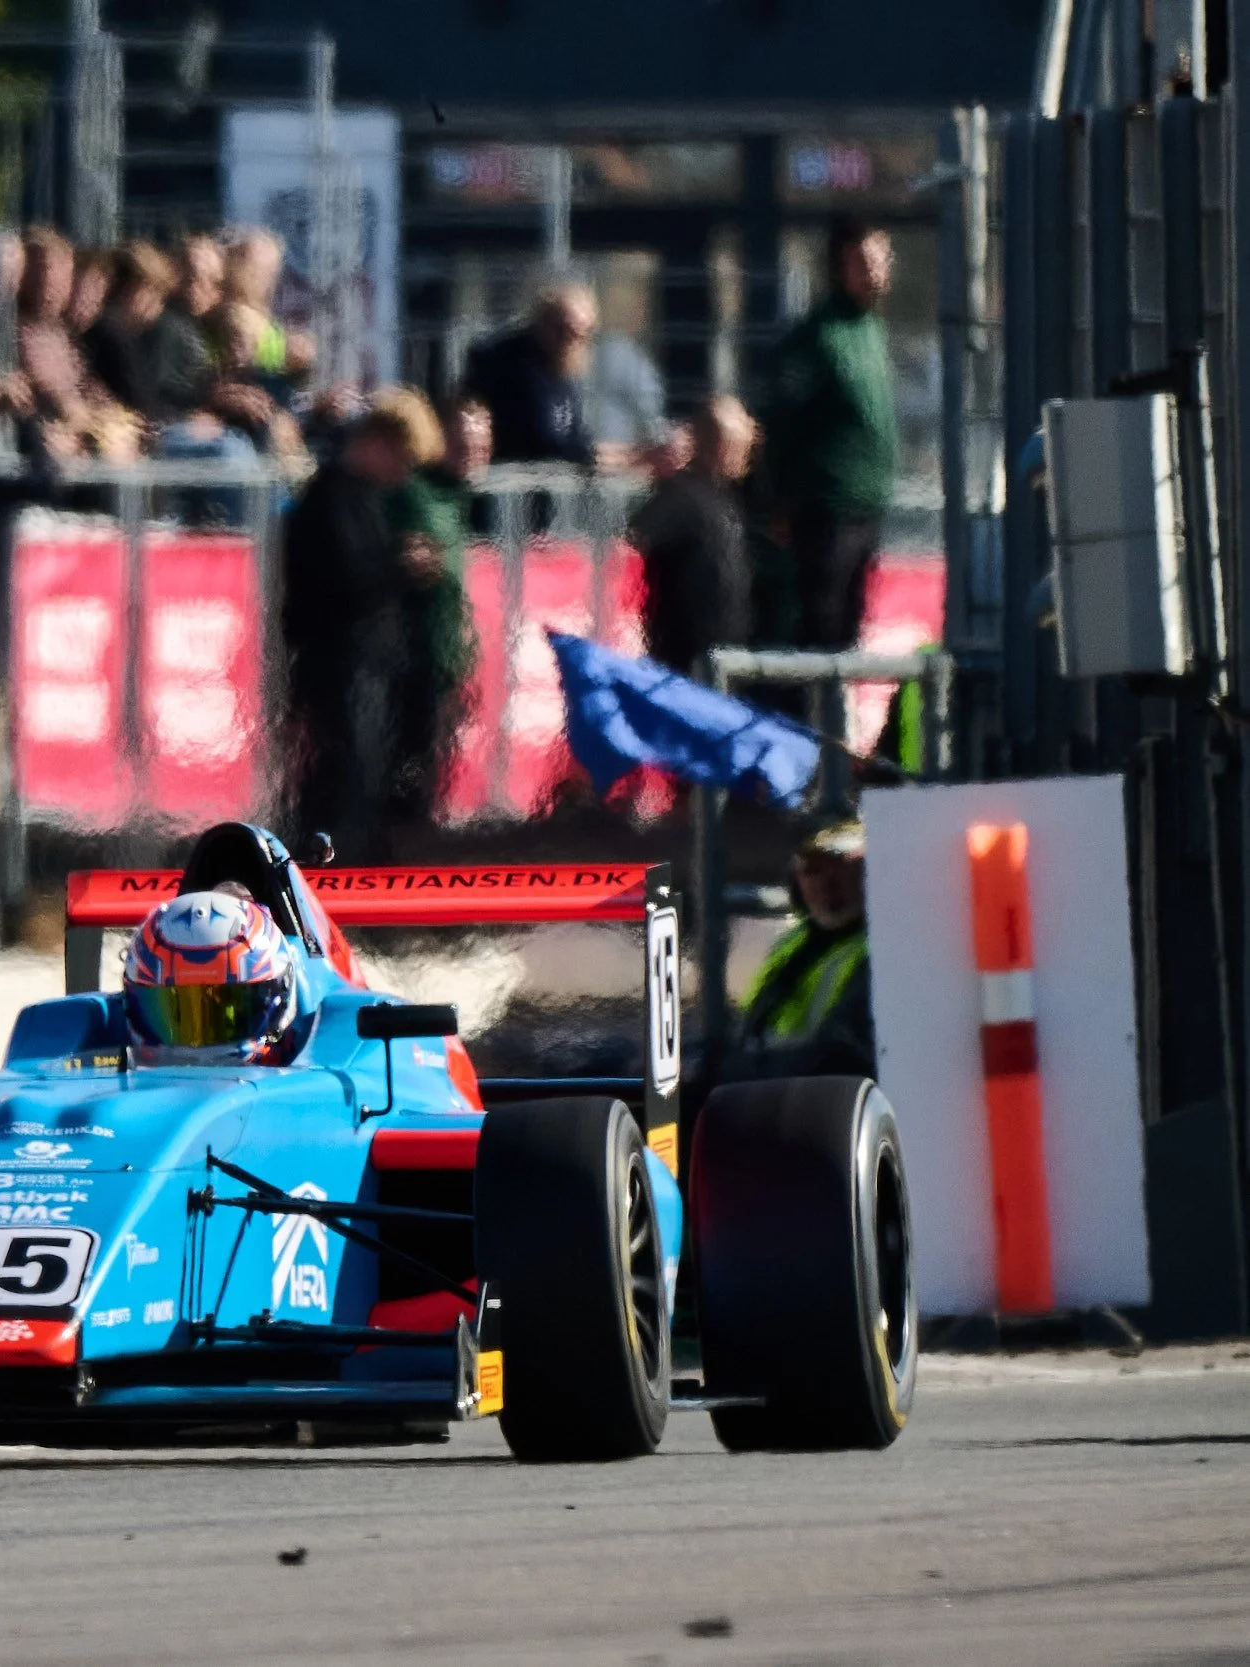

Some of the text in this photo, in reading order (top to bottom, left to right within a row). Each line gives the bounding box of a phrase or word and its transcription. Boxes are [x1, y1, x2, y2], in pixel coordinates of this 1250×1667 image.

[305, 872, 630, 890] RISTIANSEN.DK
[654, 935, 675, 1060] 15
[290, 1263, 328, 1313] HERA
